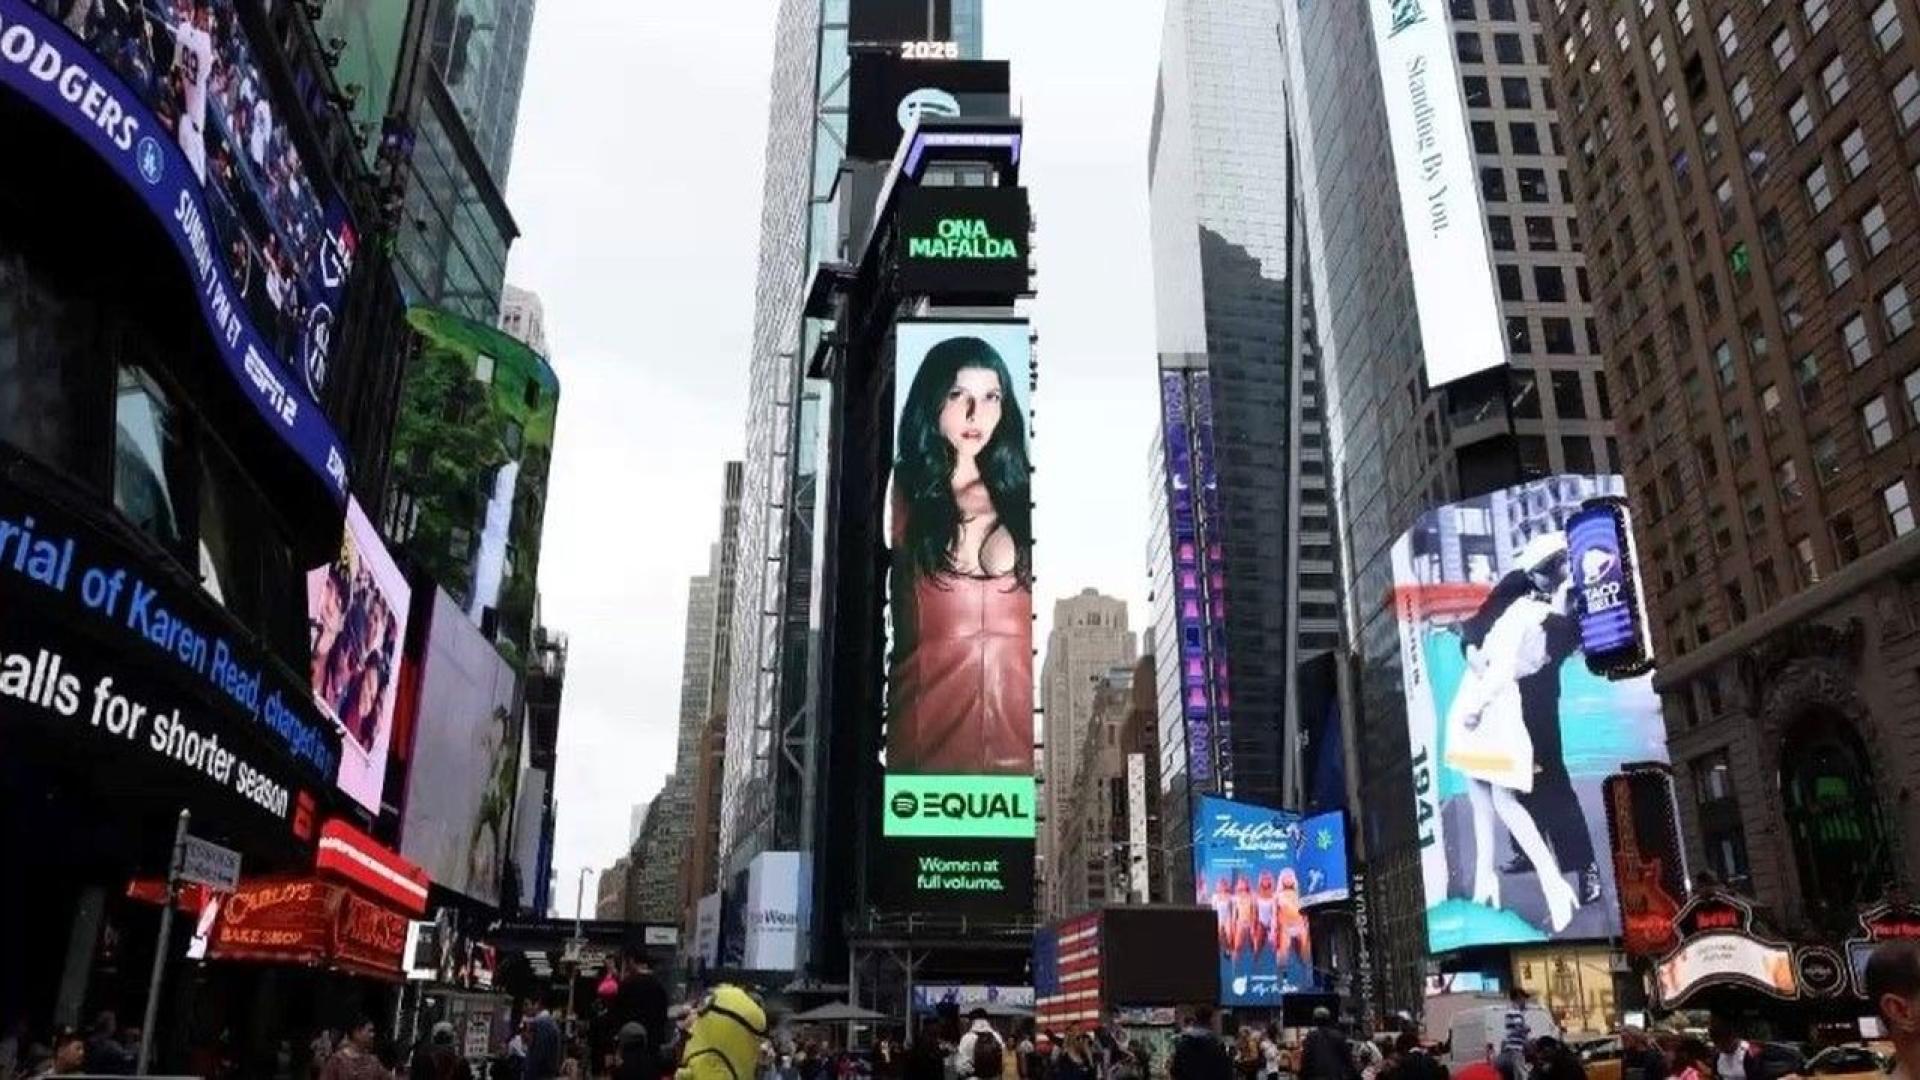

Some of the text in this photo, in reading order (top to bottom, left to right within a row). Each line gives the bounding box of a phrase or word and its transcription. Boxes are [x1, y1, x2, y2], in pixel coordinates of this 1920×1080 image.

[901, 41, 958, 59] 2025
[0, 14, 139, 151] ODGERS
[1406, 54, 1435, 152] Standing
[1422, 152, 1443, 182] By
[1427, 184, 1449, 240] You.
[174, 189, 213, 281] SUNDAY
[938, 219, 988, 239] ONA
[908, 237, 1018, 259] MAFALDA
[206, 266, 218, 295] 7
[211, 280, 232, 330] PM
[244, 344, 298, 428] ESPN2
[1582, 581, 1620, 601] TACO
[81, 565, 127, 617] of
[127, 580, 208, 674] Karen
[210, 637, 261, 722] Read,
[0, 648, 82, 717] alls
[90, 676, 148, 741] for
[150, 708, 236, 786] shorter
[235, 760, 289, 819] season
[923, 792, 1029, 819] EQUAL
[1411, 743, 1436, 850] 1941
[918, 855, 1000, 873] Women at
[917, 873, 1005, 891] full volume.
[220, 928, 303, 945] BAKE SHOP
